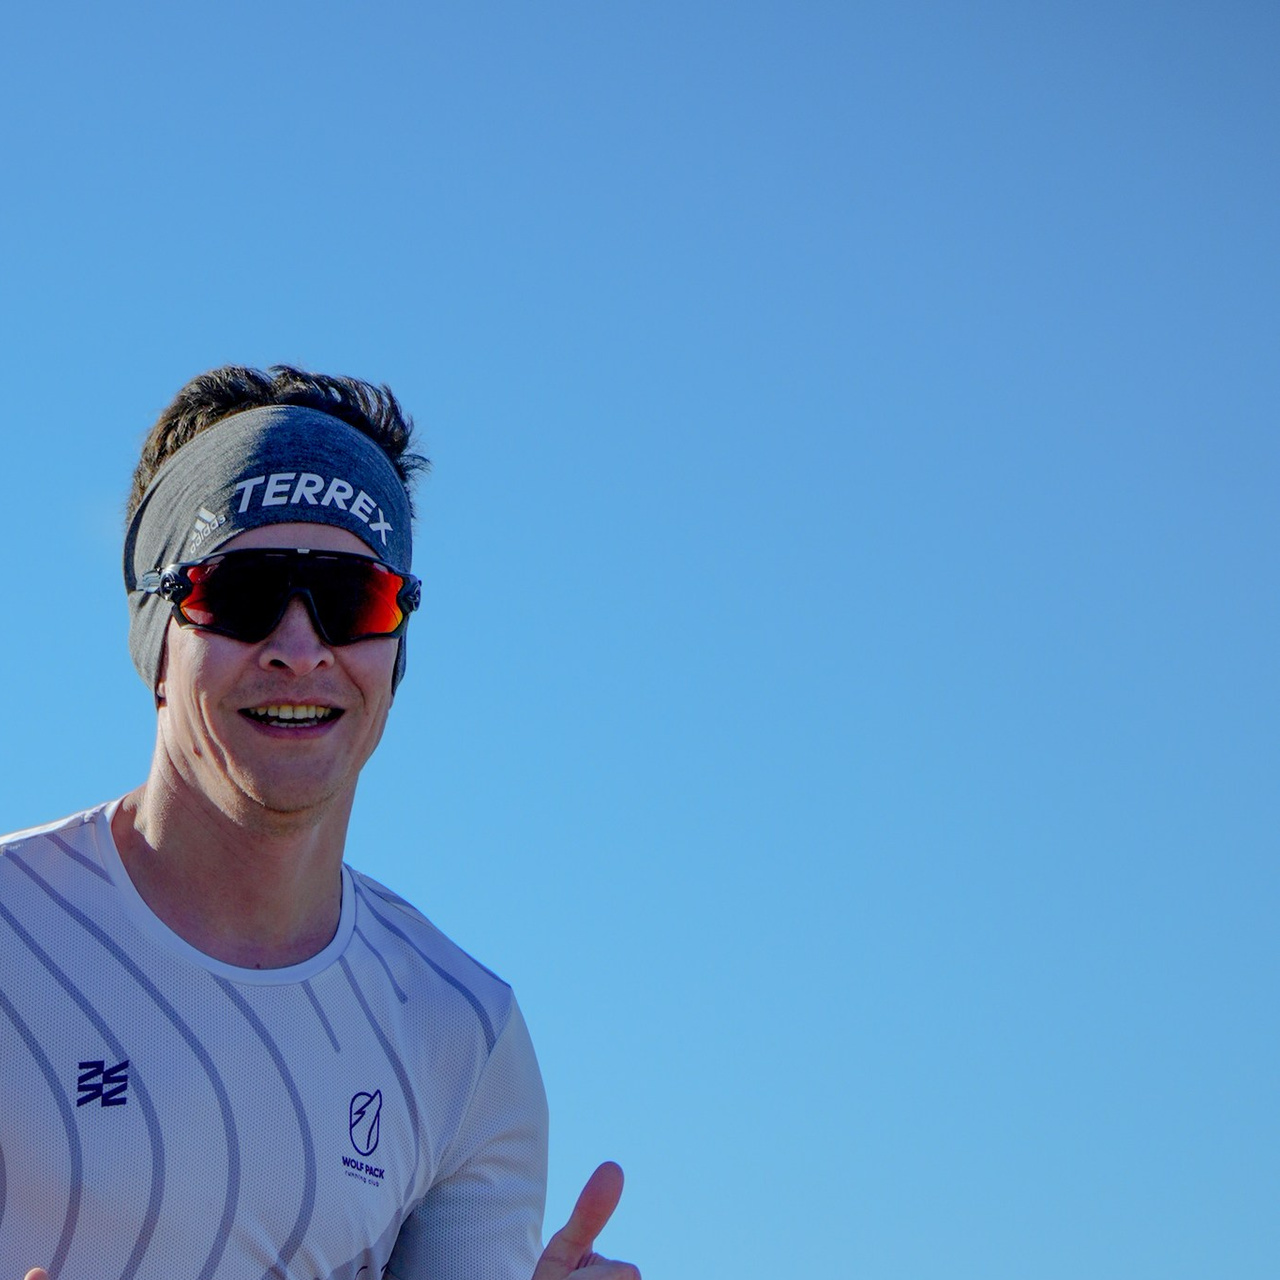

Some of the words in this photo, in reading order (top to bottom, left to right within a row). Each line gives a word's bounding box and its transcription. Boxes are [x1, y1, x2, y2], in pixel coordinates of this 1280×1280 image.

[235, 472, 394, 546] TERREX
[190, 514, 226, 554] adidas
[342, 1156, 364, 1171] WOLF
[365, 1164, 385, 1180] PACK
